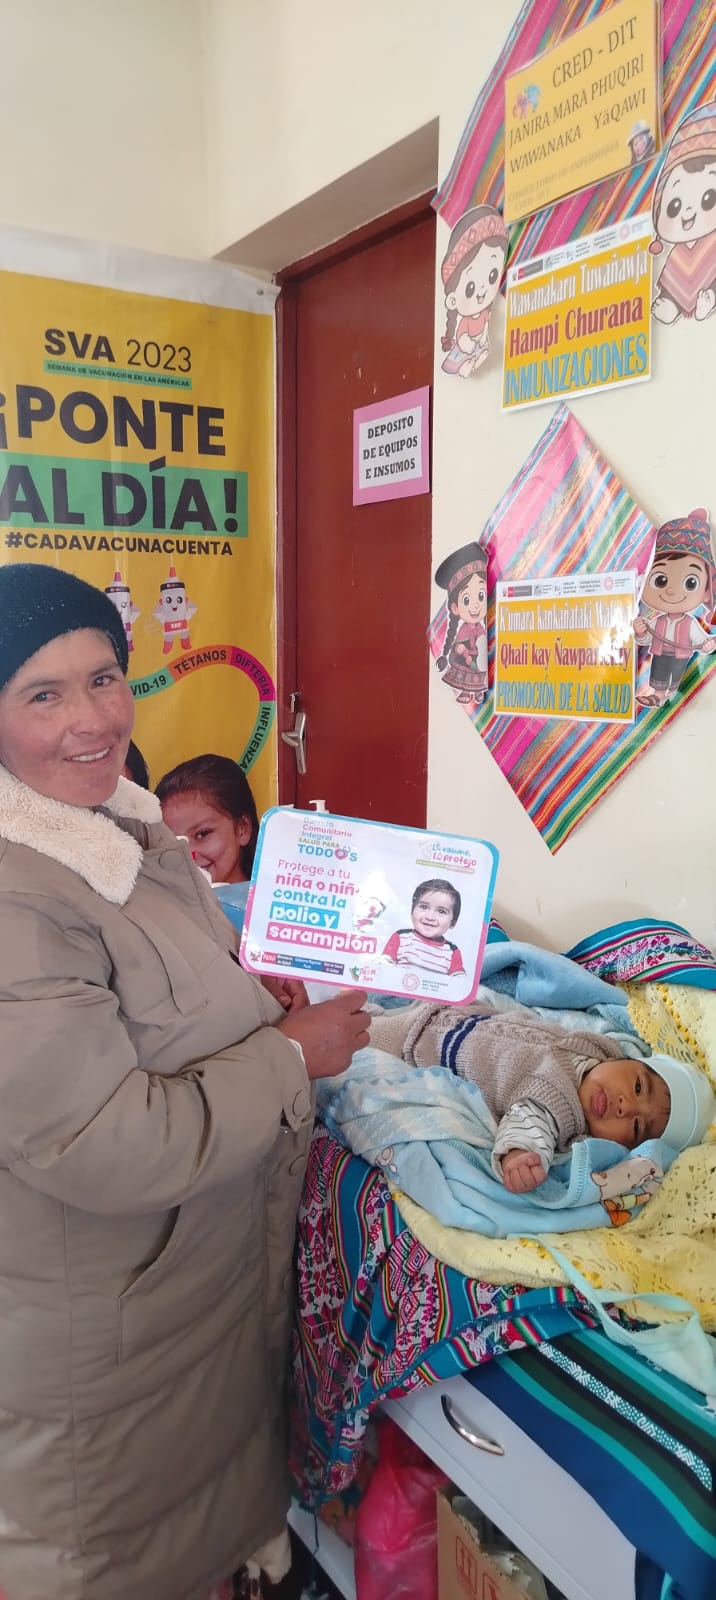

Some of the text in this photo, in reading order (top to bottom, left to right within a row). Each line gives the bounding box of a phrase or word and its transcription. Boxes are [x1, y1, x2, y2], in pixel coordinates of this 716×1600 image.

[552, 47, 593, 88] CRED
[608, 16, 638, 53] DIT
[509, 53, 644, 148] JANIRA MARA PHUQIRI
[510, 125, 582, 174] WAWANAKA
[509, 275, 577, 319] Wawanakaru
[580, 243, 648, 295] Tuwañawja
[509, 296, 643, 358] Hampi Churana
[44, 328, 192, 372] SVA 2023
[77, 367, 87, 375] DE
[504, 333, 648, 405] INMUNIZACIONES
[367, 415, 414, 439] DEPOSITO
[363, 436, 418, 460] DE EQUIPOS
[365, 458, 416, 479] E INSUMOS
[0, 456, 239, 533] AL DÍA!
[5, 531, 233, 556] #CADAVACUNACUENTA
[174, 650, 227, 675] TÉTANOS
[500, 643, 528, 669] Qhali
[531, 643, 551, 671] kay
[235, 654, 270, 697] DIFTERIA
[497, 674, 631, 714] PROMOCIÓN DE LA SALUD
[239, 706, 271, 770] INFLUENZA
[299, 837, 321, 846] SALUD
[302, 824, 352, 838] Comunitario
[278, 859, 351, 879] Protege a tu
[273, 888, 347, 909] contra la
[275, 873, 360, 896] niña o niñ
[273, 904, 337, 928] polio y
[268, 925, 377, 953] sarampión
